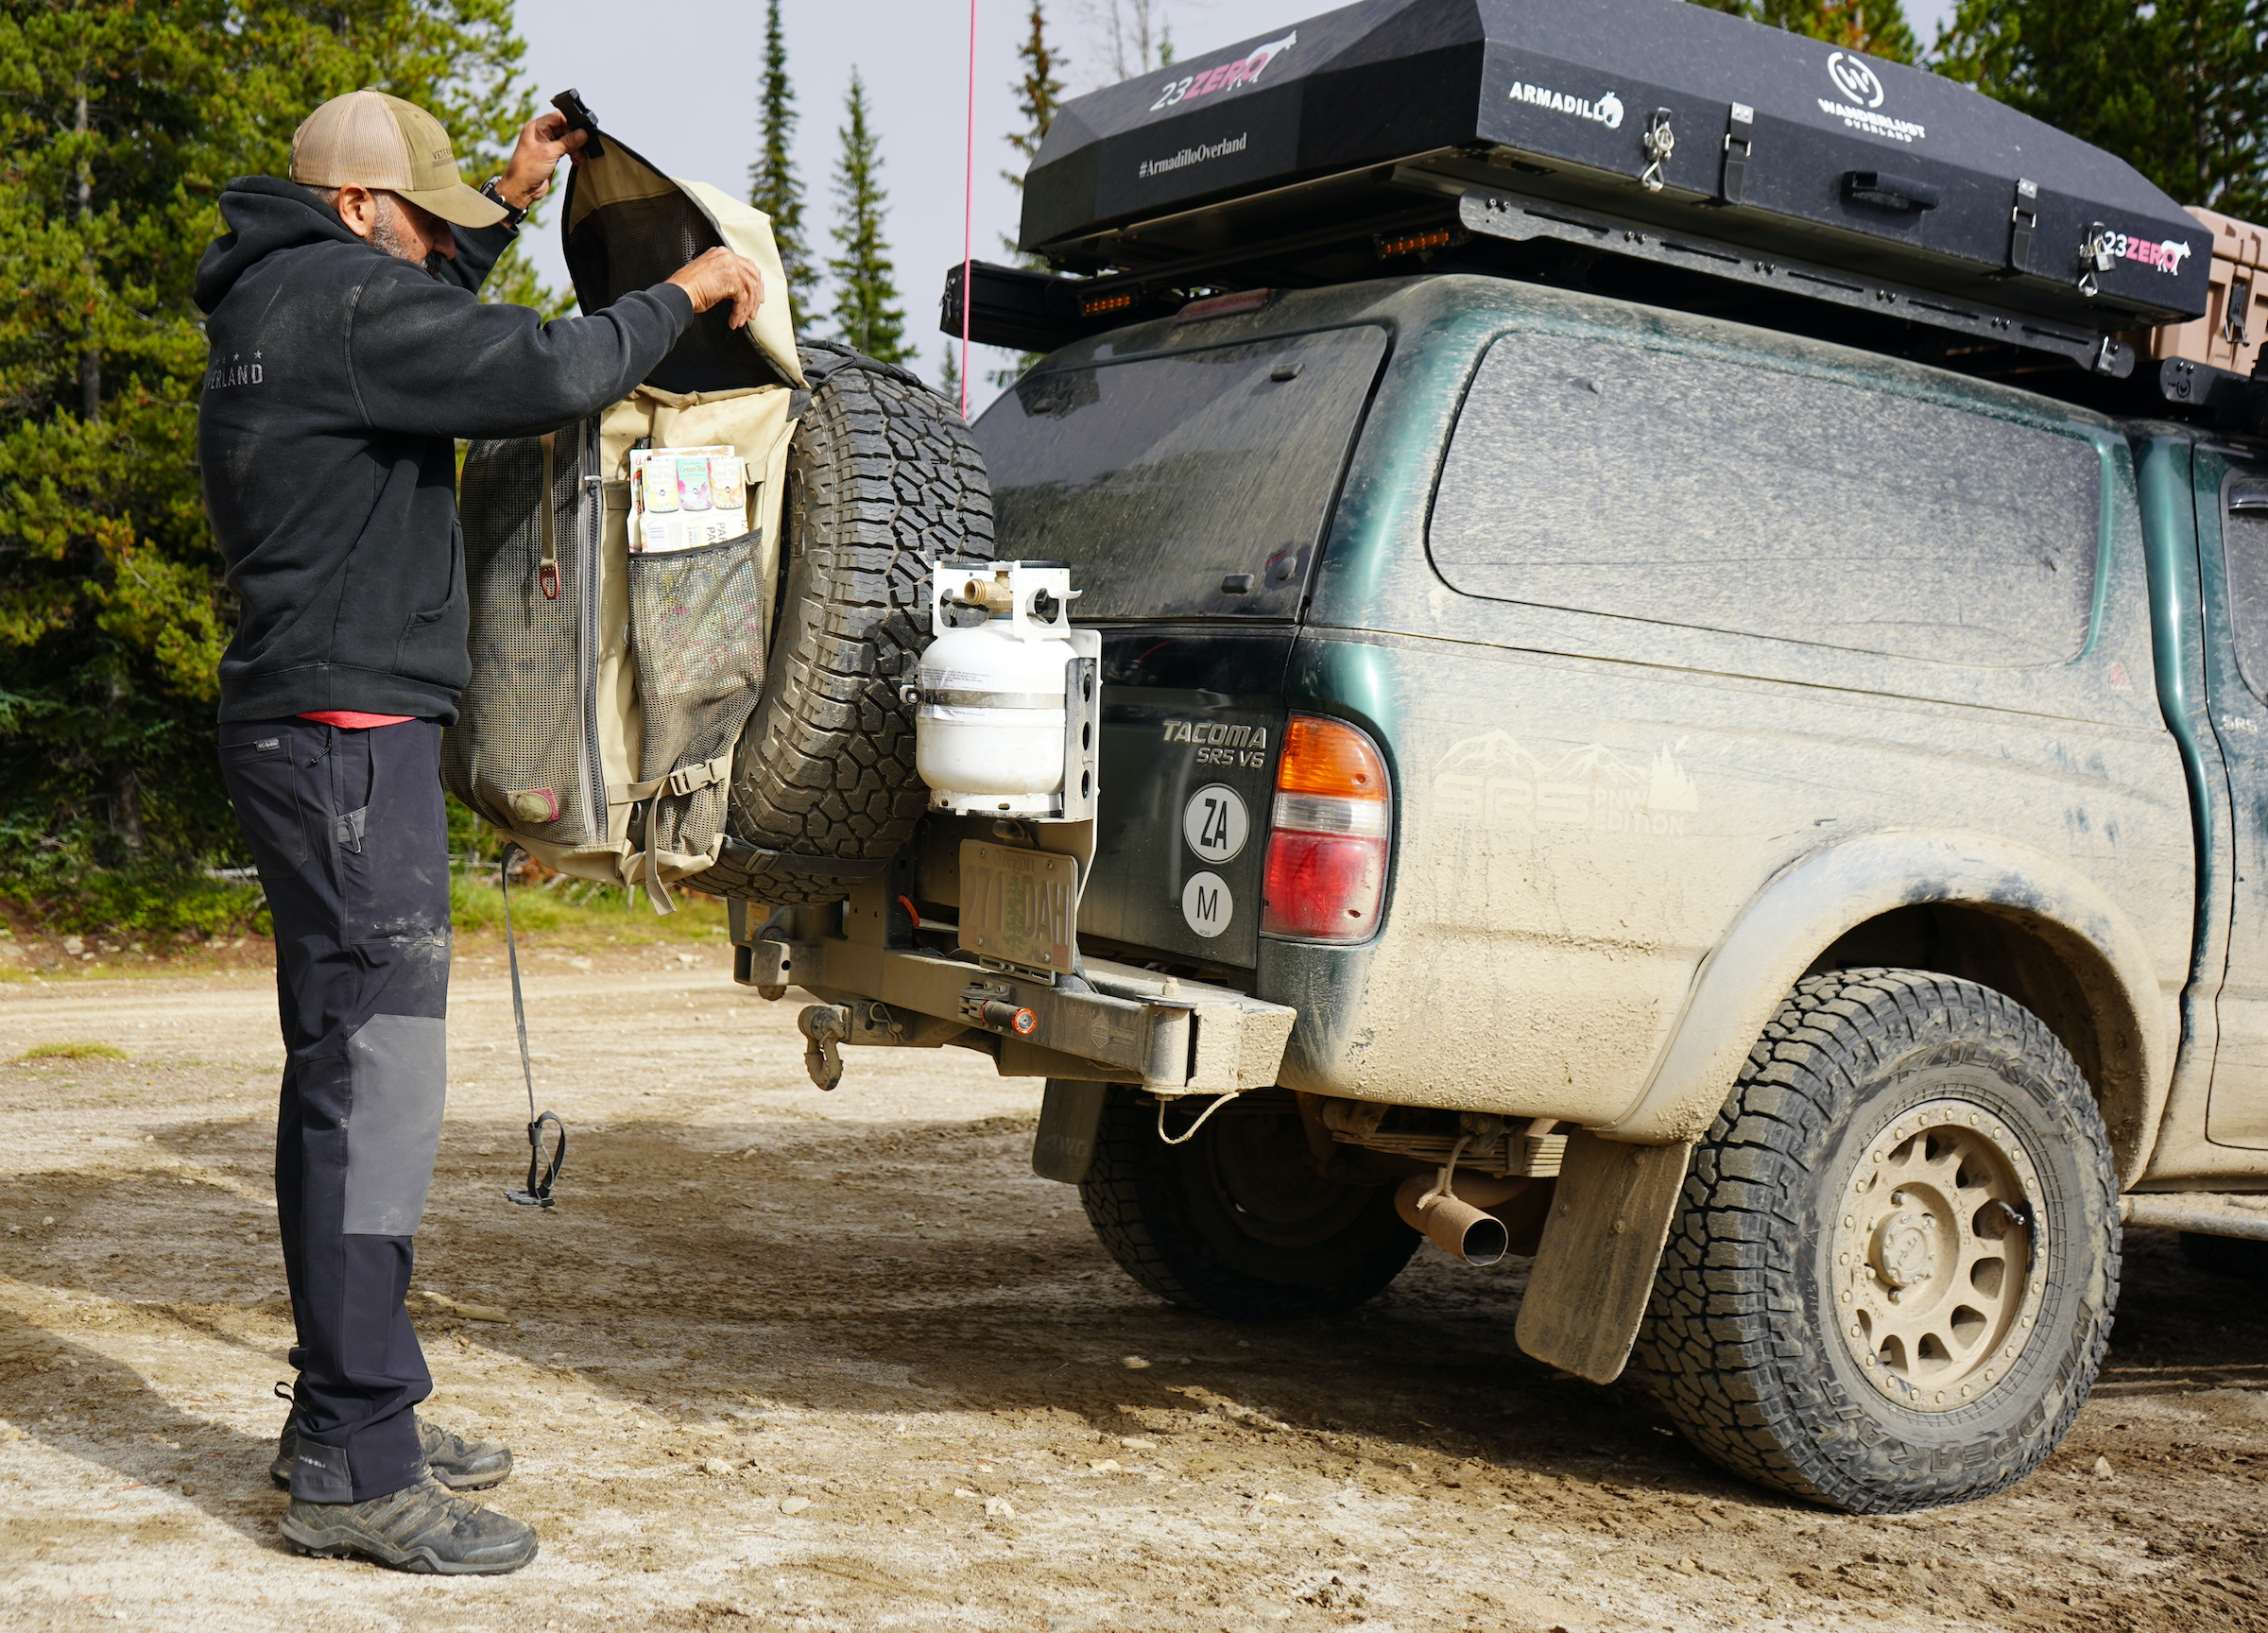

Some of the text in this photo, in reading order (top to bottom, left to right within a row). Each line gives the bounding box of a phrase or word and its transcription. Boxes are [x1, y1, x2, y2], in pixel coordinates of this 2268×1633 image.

[1149, 51, 1268, 112] 23ZERO
[1817, 97, 1926, 139] WANDERLUST
[1844, 117, 1913, 143] OVERLAND
[1139, 131, 1247, 179] #ArmadilloOverland
[2105, 230, 2176, 270] 23ZERO
[1162, 720, 1267, 750] TACOMA
[1196, 748, 1265, 769] SR5 V6
[1200, 799, 1228, 851] ZA
[1594, 808, 1685, 836] EDITION
[993, 848, 1037, 875] Oregon
[1022, 874, 1070, 946] DAH
[1196, 886, 1218, 922] M
